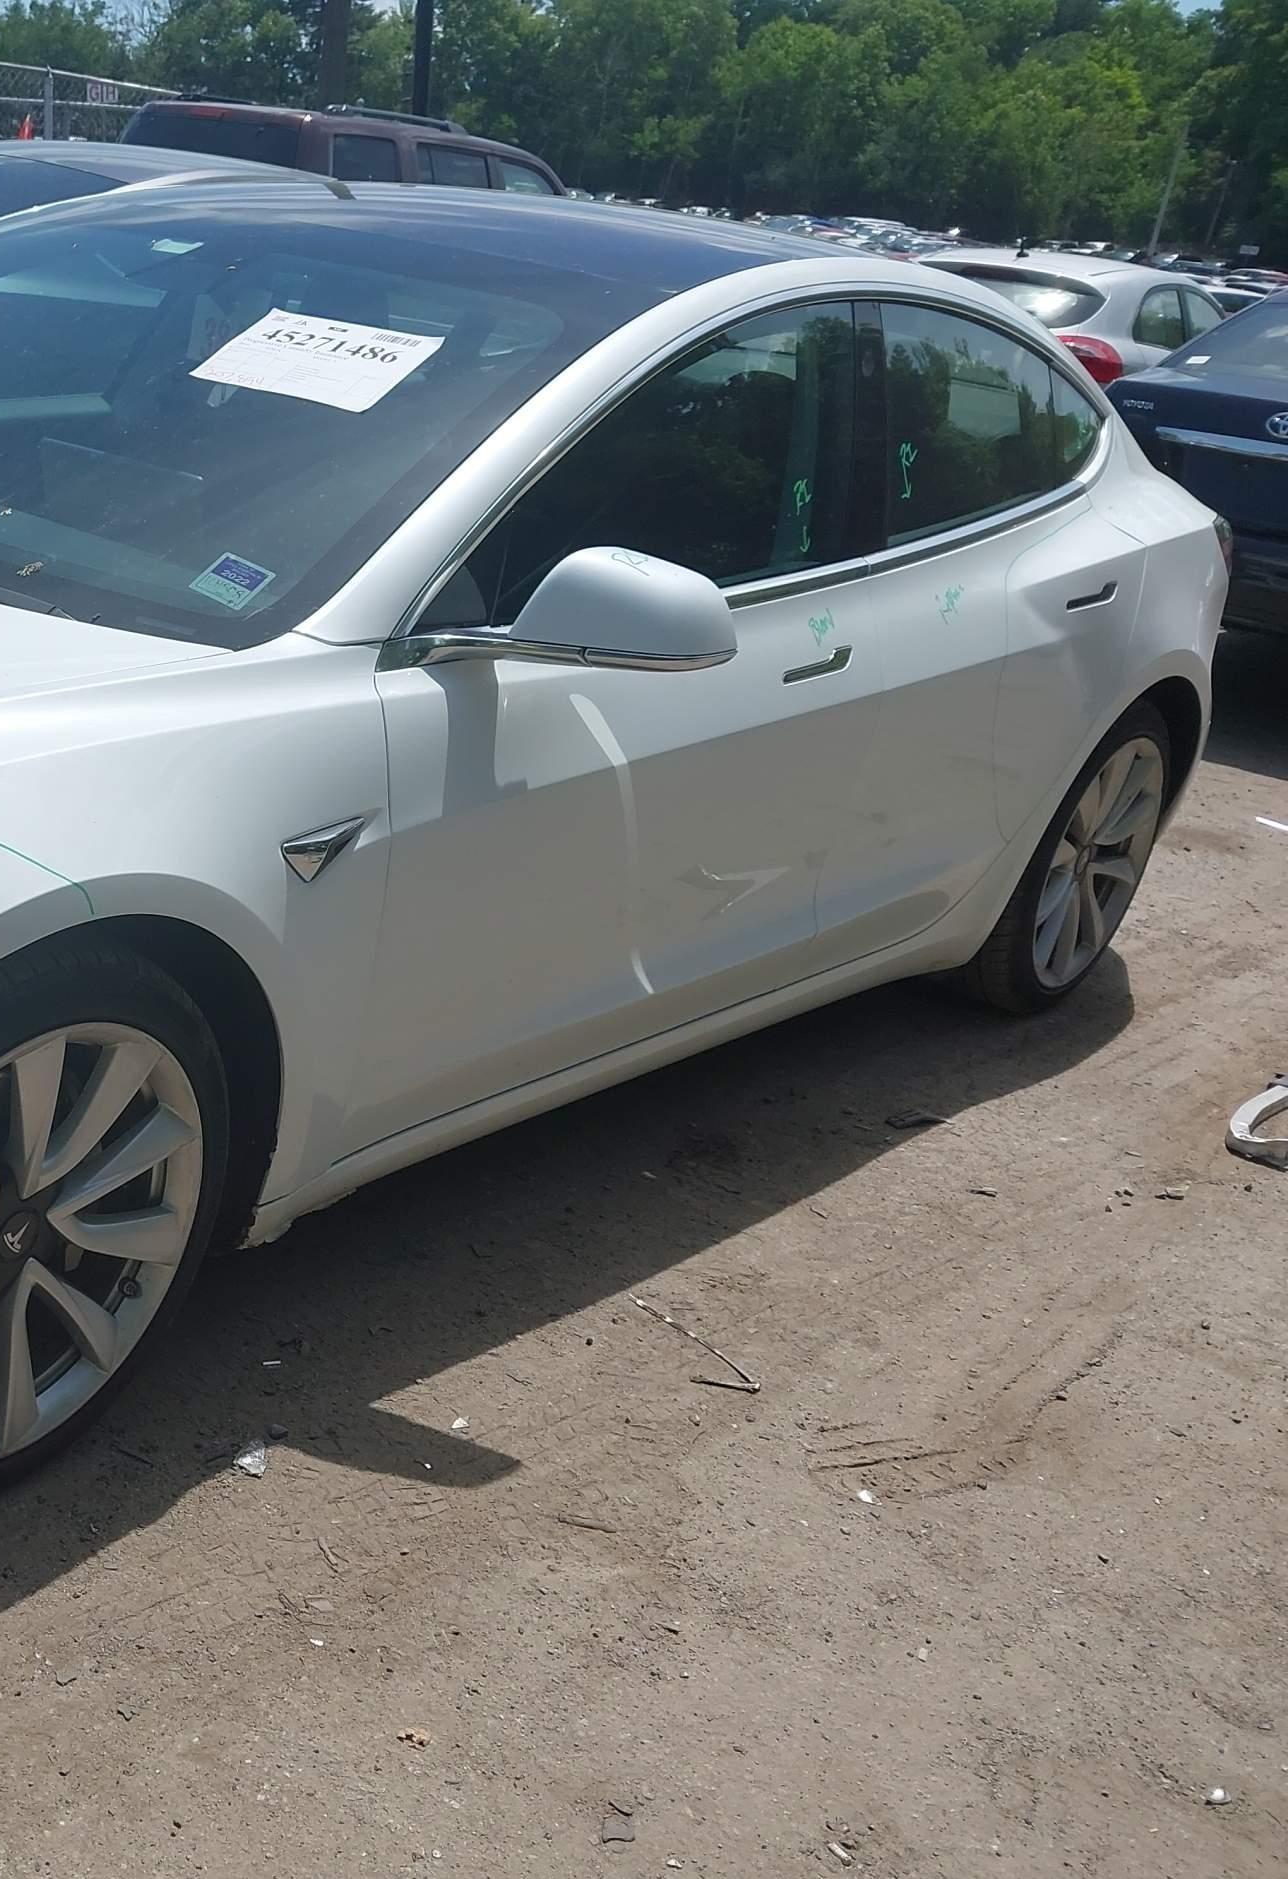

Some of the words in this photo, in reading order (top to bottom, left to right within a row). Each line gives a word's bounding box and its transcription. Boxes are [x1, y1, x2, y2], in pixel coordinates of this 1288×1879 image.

[261, 329, 400, 363] 45271486
[1122, 399, 1155, 410] TOYOTA
[219, 569, 250, 587] 2022
